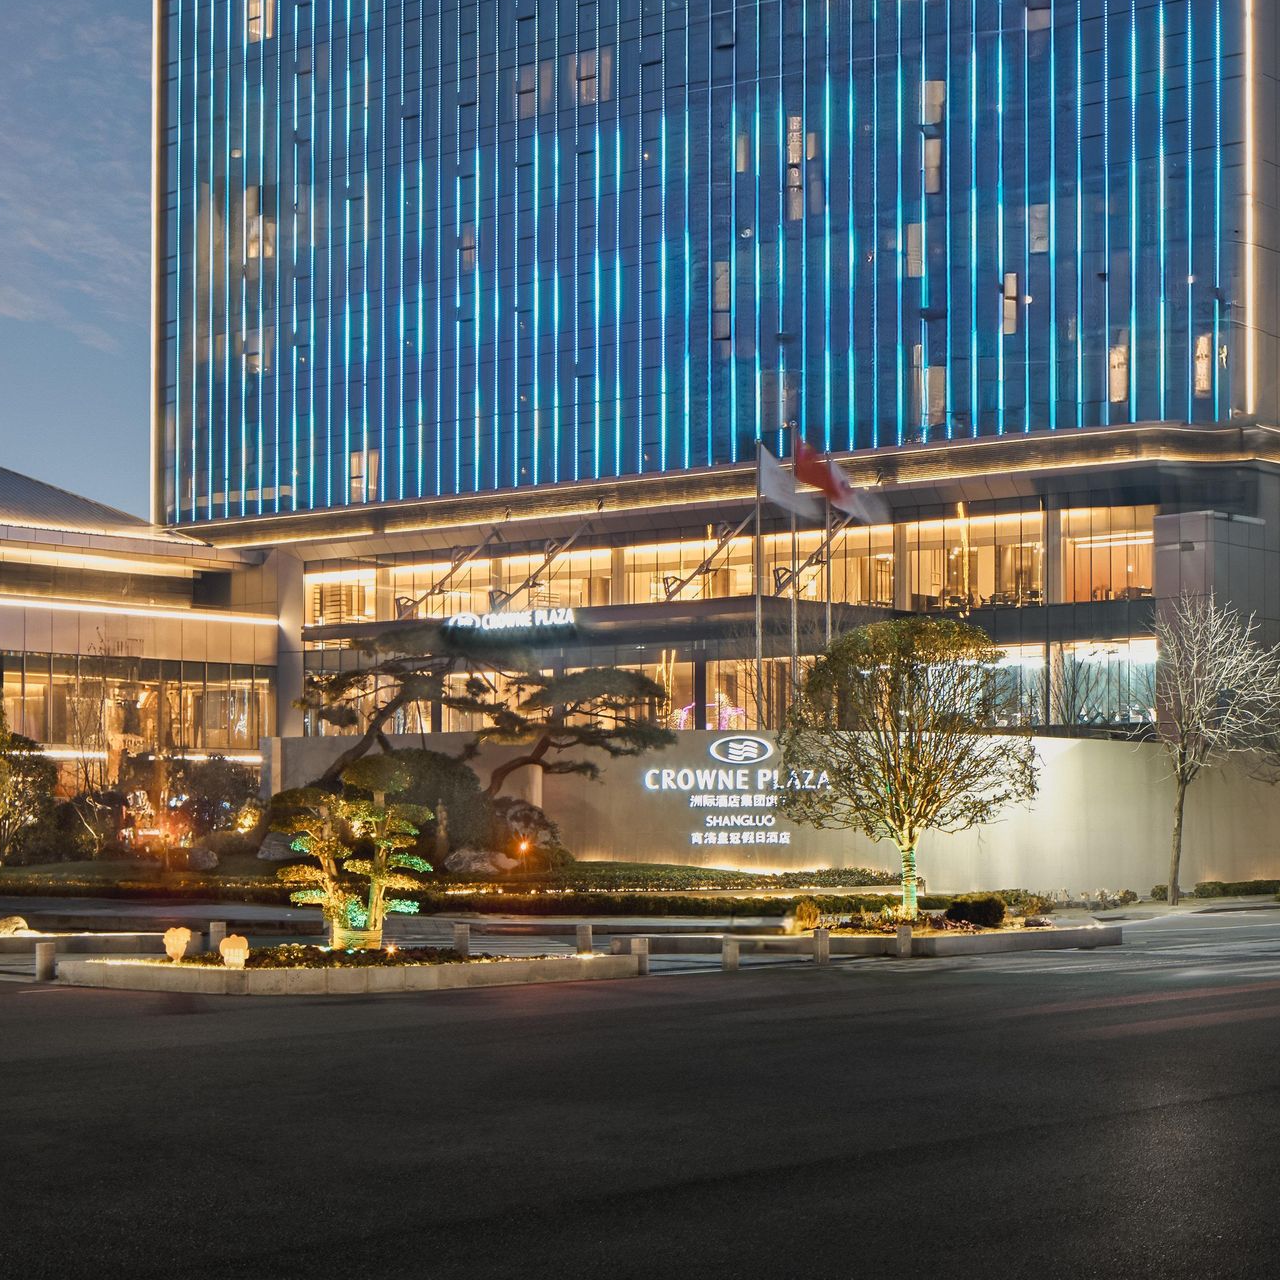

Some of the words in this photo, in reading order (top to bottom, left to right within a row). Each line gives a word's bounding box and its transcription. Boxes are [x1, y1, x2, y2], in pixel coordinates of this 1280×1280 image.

[481, 610, 533, 630] CROWNE
[535, 607, 575, 625] PLAZA
[644, 769, 749, 790] CROWNE
[757, 769, 832, 790] PLAZA
[705, 814, 776, 827] SHANGLUO
